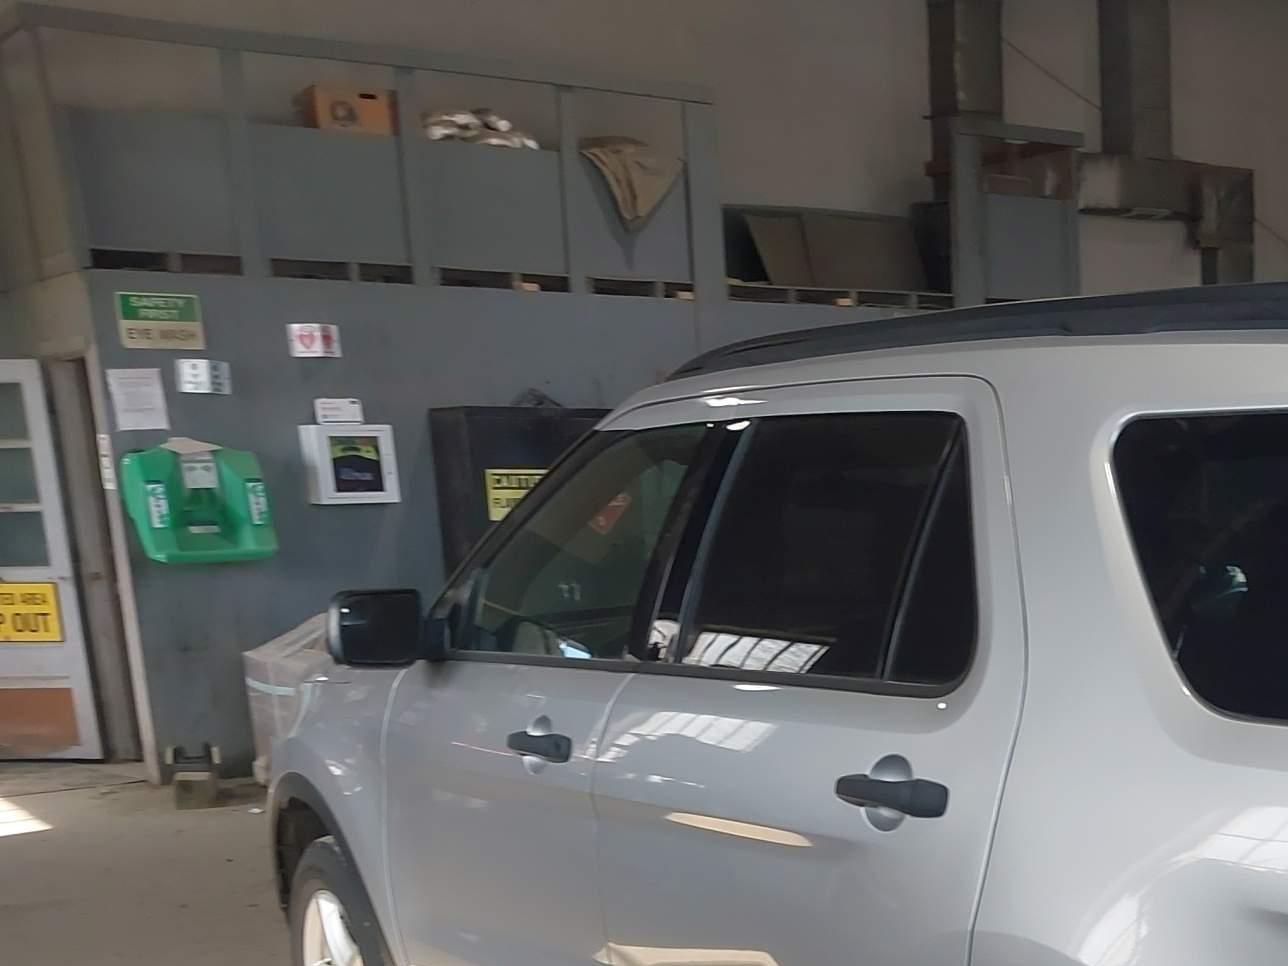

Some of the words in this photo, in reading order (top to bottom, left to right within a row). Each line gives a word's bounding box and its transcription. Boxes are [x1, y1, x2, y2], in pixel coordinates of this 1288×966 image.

[129, 296, 187, 308] SAFETY
[138, 308, 179, 320] FIRST
[127, 327, 153, 340] EYE
[159, 327, 196, 340] WASH
[20, 592, 48, 606] AREA
[11, 612, 51, 633] OUT
